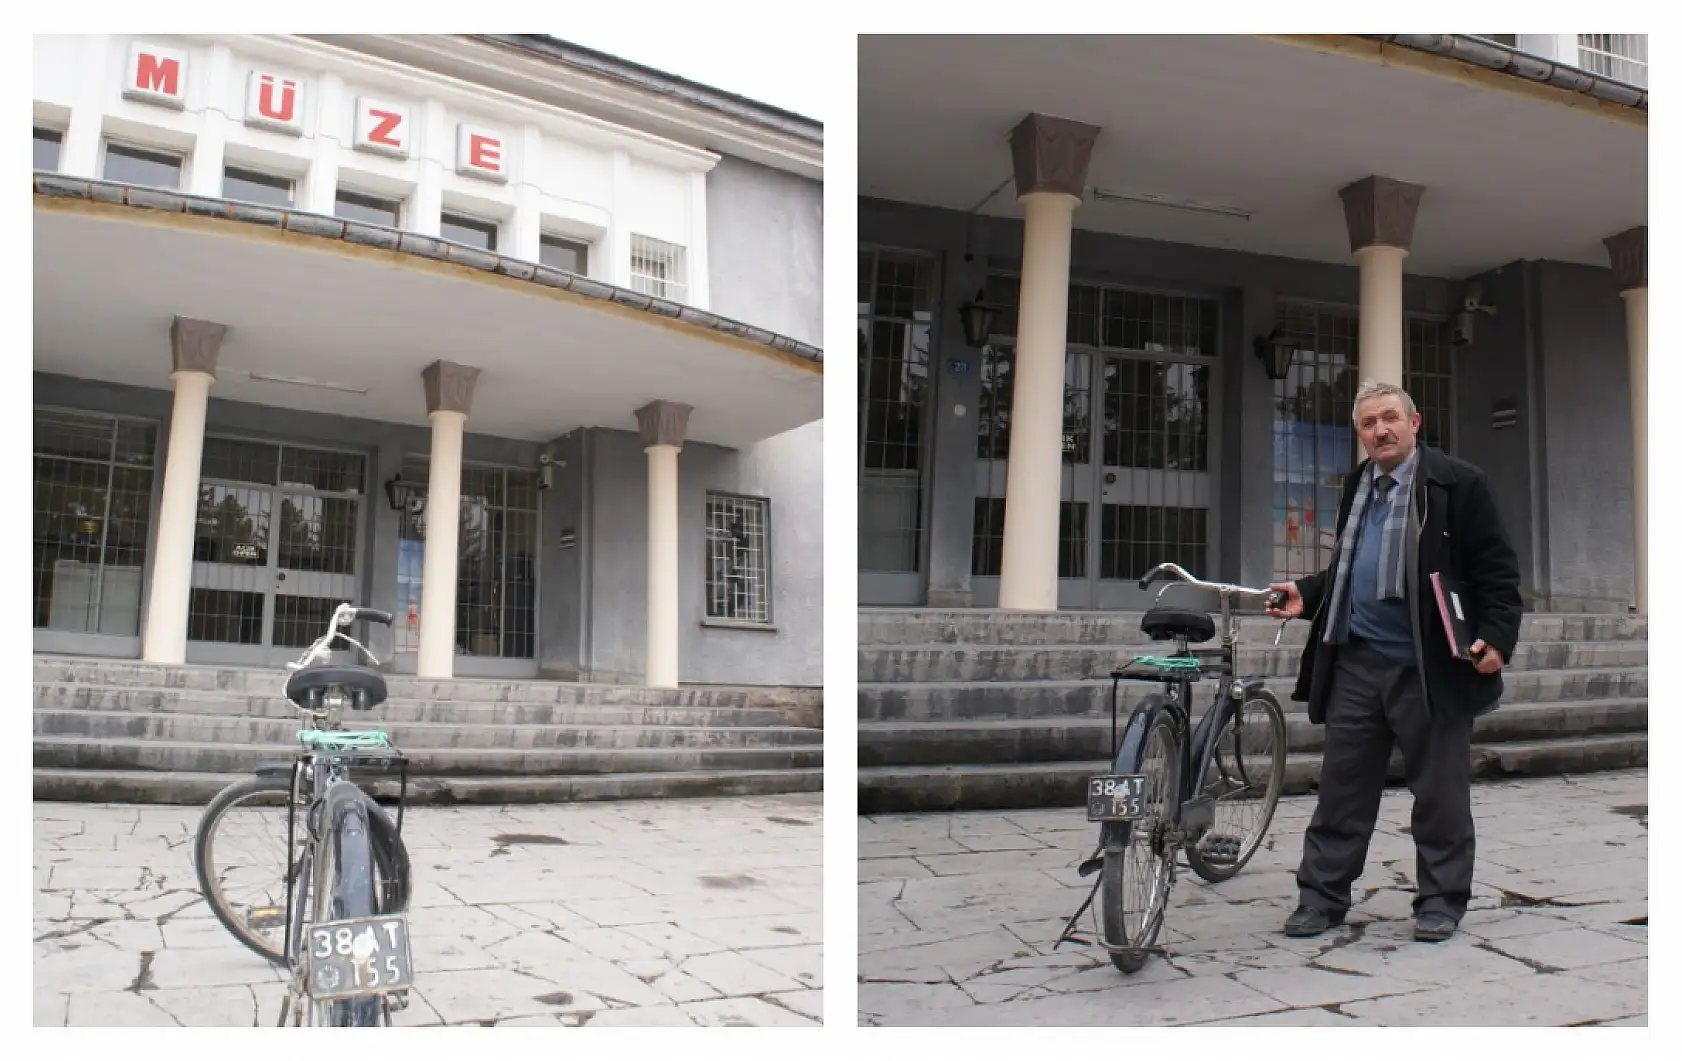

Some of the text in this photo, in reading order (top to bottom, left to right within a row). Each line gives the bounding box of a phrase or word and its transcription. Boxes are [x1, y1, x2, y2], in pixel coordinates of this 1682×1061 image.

[136, 53, 501, 171] MÜZE
[1112, 797, 1140, 816] 155
[350, 955, 400, 987] 155
